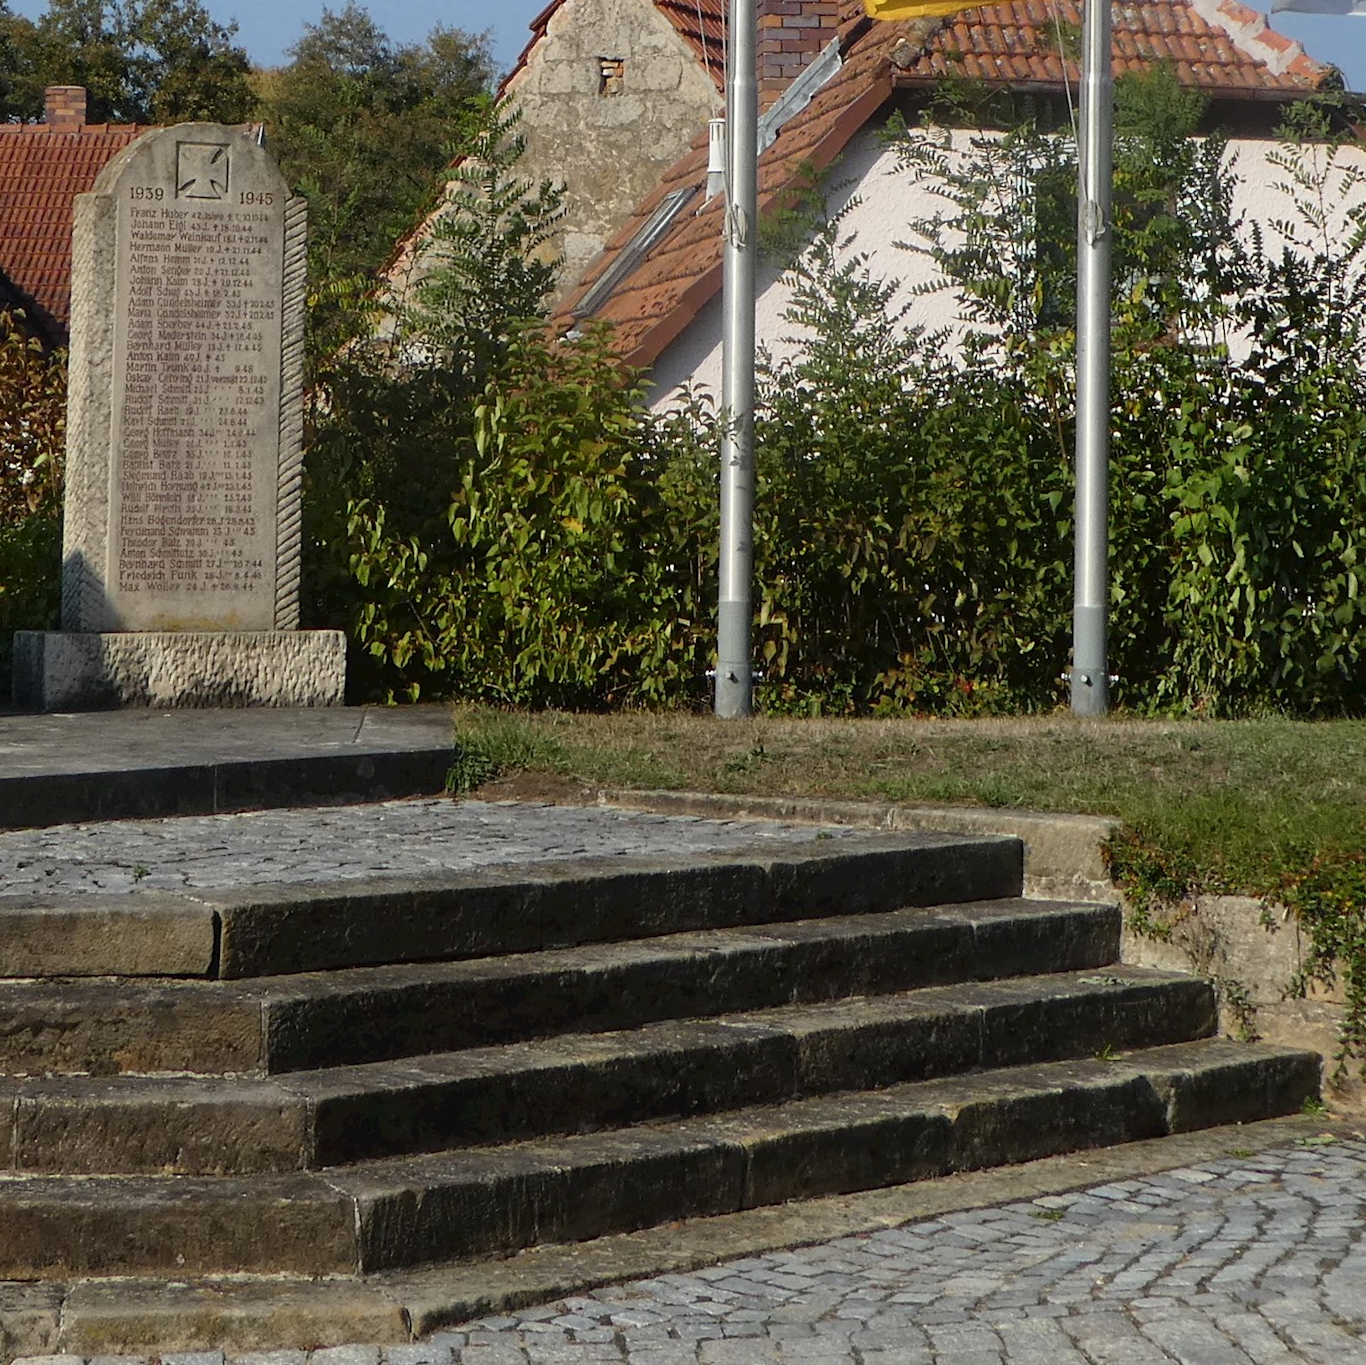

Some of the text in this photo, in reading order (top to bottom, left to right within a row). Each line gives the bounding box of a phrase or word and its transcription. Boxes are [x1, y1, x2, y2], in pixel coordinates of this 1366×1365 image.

[130, 187, 164, 201] 1939
[240, 192, 274, 205] 1945
[131, 207, 156, 217] Franz
[161, 208, 188, 219] Huber
[131, 220, 164, 229] Johann
[131, 230, 175, 241] Waldemar
[130, 242, 170, 252] Hermann
[130, 265, 156, 275] Anton
[130, 276, 162, 285] Johann
[129, 286, 152, 296] Adolf
[129, 298, 154, 307] Adam
[128, 319, 153, 328] Adam
[127, 352, 153, 361] Anton
[127, 362, 156, 372] Martin
[171, 570, 197, 579] Funk
[119, 582, 140, 591] Max
